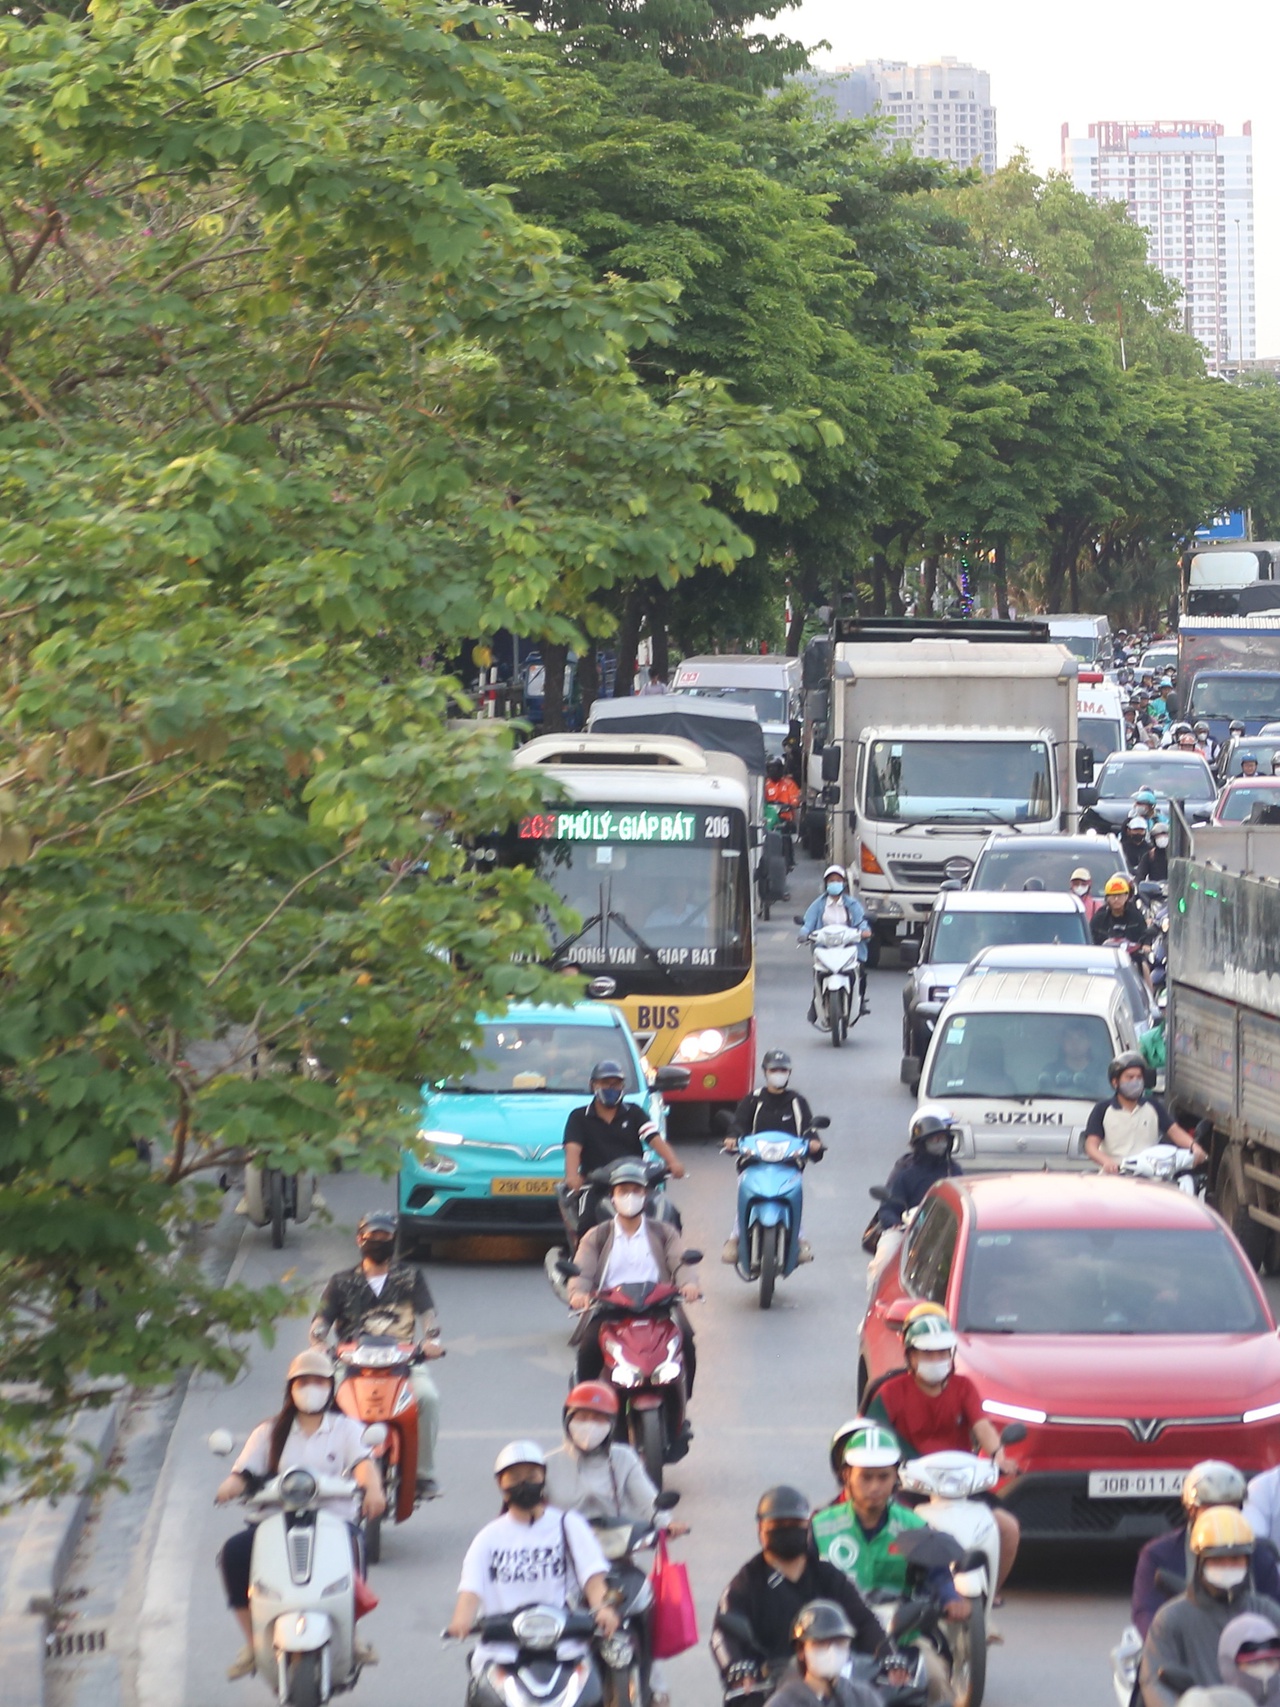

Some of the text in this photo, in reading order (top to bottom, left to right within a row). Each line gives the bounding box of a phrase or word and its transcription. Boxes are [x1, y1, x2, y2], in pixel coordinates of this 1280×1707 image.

[704, 815, 730, 839] 206
[638, 1005, 680, 1028] BUS
[984, 1112, 1064, 1124] SUZUKI
